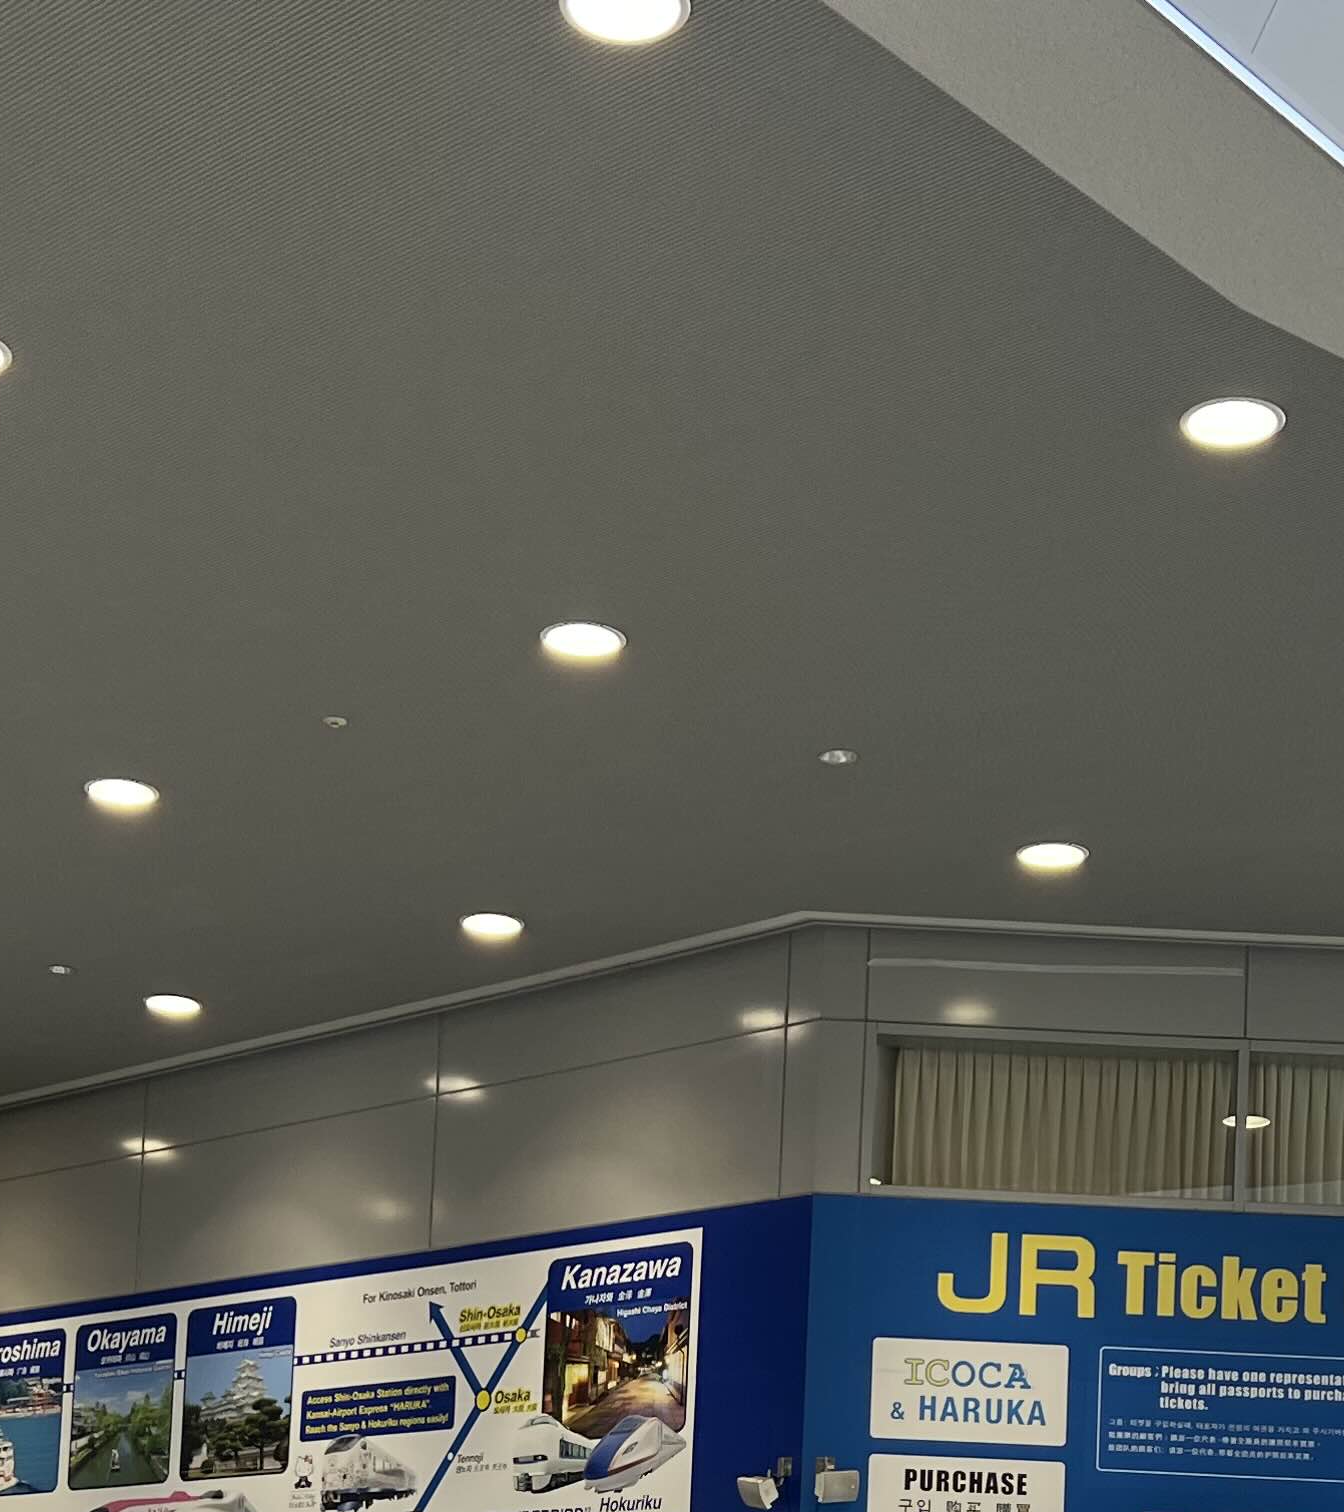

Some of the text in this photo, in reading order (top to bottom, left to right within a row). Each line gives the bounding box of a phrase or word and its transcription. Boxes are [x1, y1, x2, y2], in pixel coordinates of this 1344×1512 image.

[561, 1256, 682, 1290] Kanazawa
[937, 1232, 1096, 1318] JR
[1117, 1250, 1327, 1325] Ticket
[362, 1293, 376, 1304] For
[378, 1288, 415, 1302] Kinosaki
[449, 1280, 477, 1293] Tottori
[212, 1306, 273, 1336] Himeji
[459, 1303, 521, 1323] Shin-Osaka
[87, 1326, 167, 1353] Okayama
[330, 1331, 407, 1349] Sanyo Shinkansen
[904, 1357, 1032, 1390] ICOCA
[1109, 1363, 1151, 1378] Groups
[1161, 1366, 1204, 1381] Please
[1208, 1368, 1238, 1382] have
[1242, 1371, 1266, 1383] one
[494, 1389, 531, 1403] Osaka
[1161, 1381, 1195, 1396] bring
[1199, 1383, 1216, 1396] all
[1219, 1385, 1284, 1401] passports
[1288, 1388, 1301, 1400] to
[890, 1396, 1046, 1427] & HARUKA
[1160, 1397, 1208, 1411] tickets.
[904, 1468, 1027, 1496] PURCHASE
[599, 1495, 662, 1512] Hokuriku
